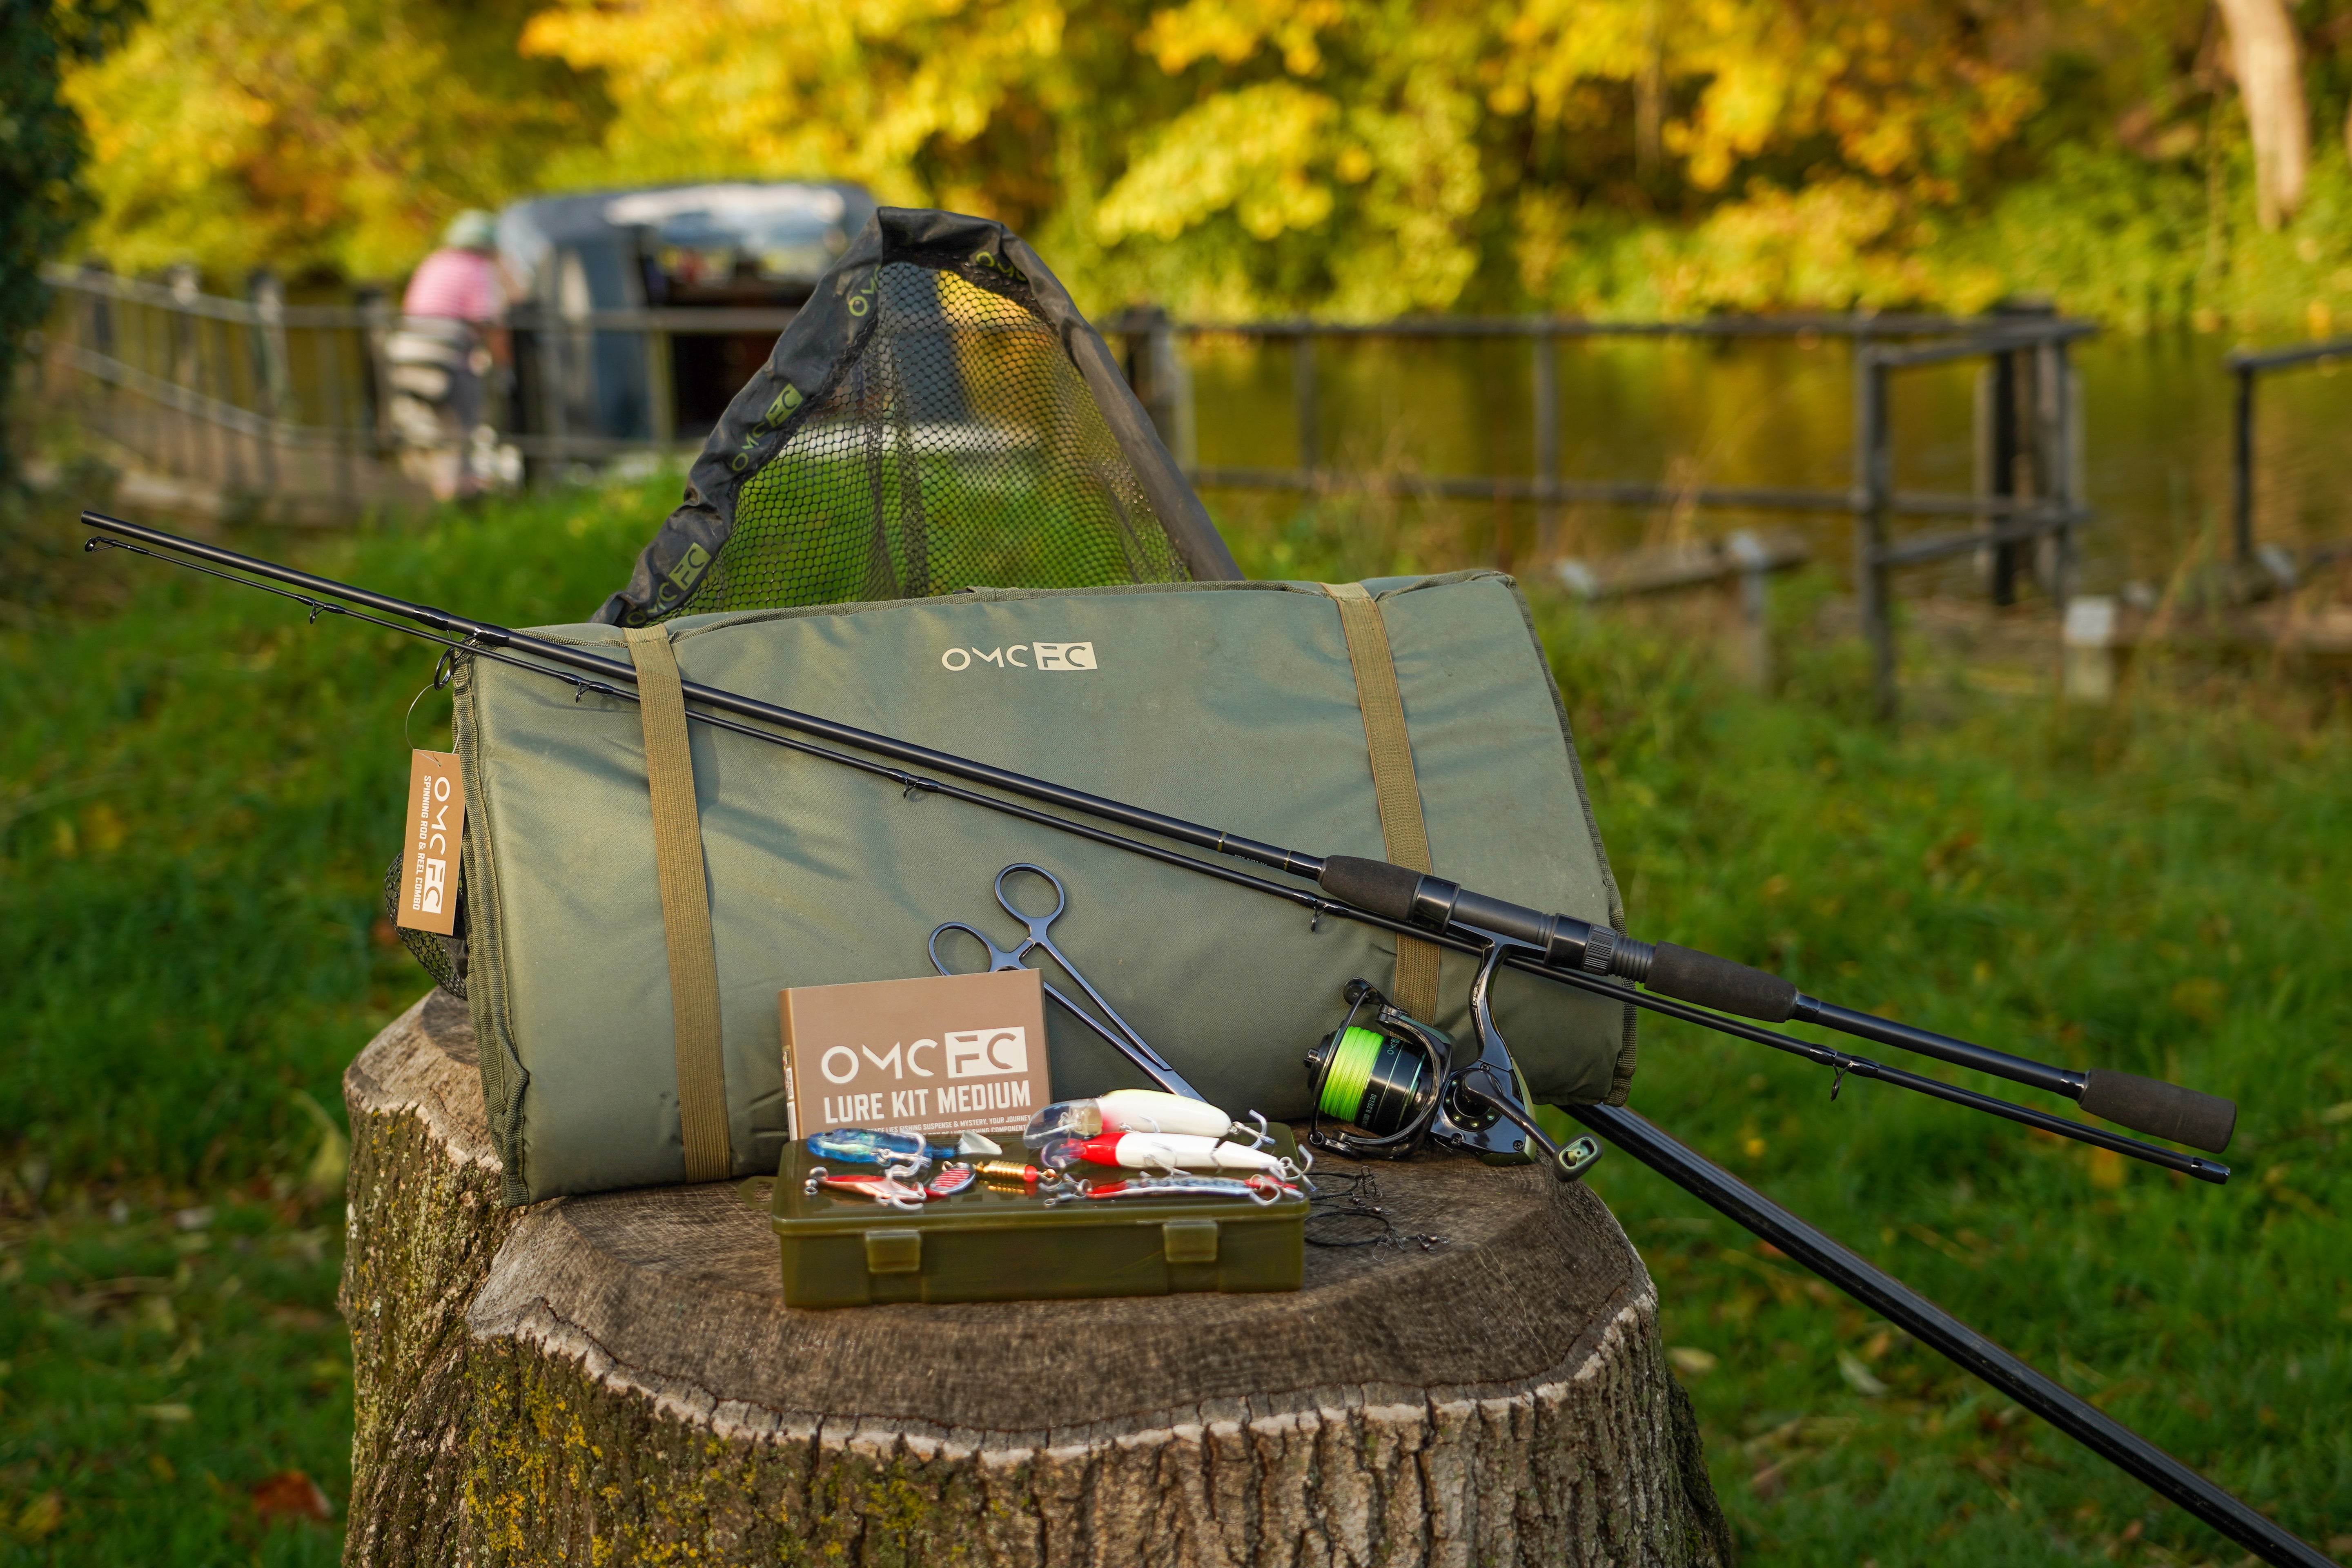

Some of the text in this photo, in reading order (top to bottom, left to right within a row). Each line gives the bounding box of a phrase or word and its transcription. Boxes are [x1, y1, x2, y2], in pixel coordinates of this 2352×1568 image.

[412, 775, 432, 910] SPINNING ROD & REEL COMBO
[824, 1080, 1031, 1124] LURE KIT MEDIUM
[923, 1121, 953, 1130] SUSPENSE
[960, 1118, 988, 1127] MYSTERY.
[1006, 1114, 1031, 1123] JOURNEY
[991, 1124, 1028, 1133] COMPONENT
